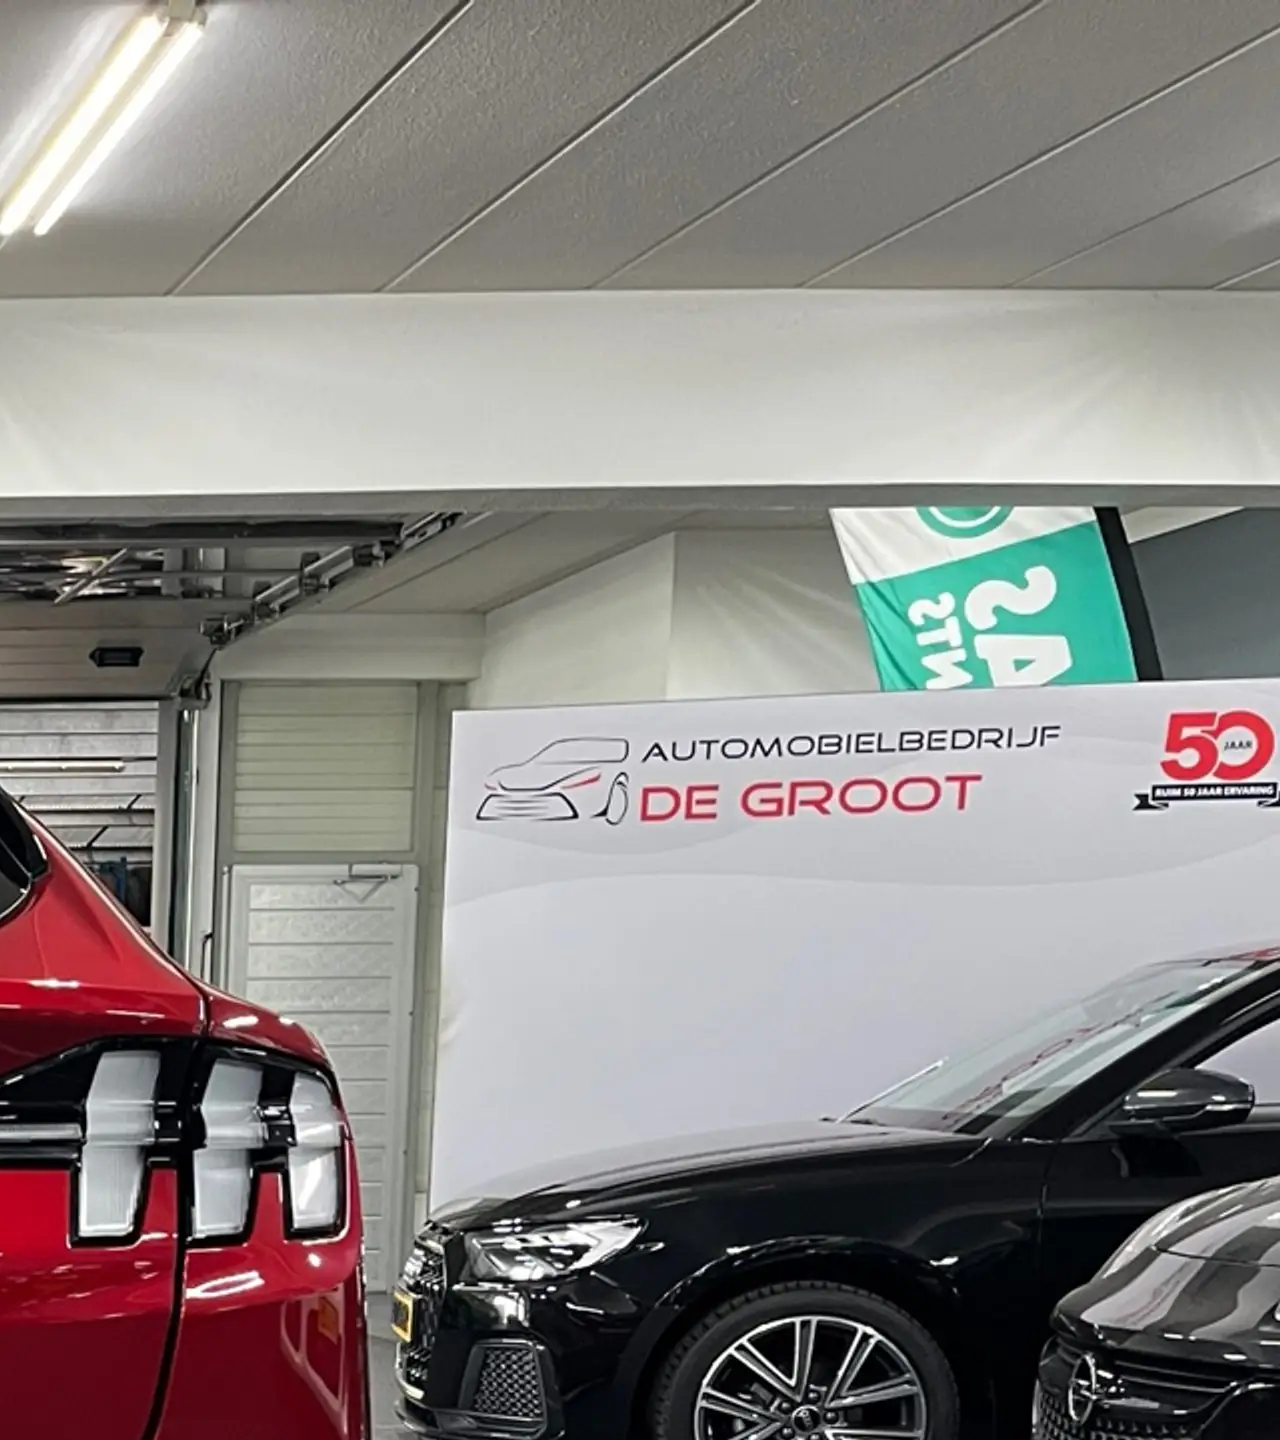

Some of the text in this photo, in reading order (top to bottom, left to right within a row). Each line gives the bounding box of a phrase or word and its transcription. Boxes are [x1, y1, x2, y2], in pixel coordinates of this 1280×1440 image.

[642, 726, 1061, 763] AUTOMOBIELBEDRIJF
[1160, 710, 1275, 781] 50
[640, 775, 982, 821] DE GROOT
